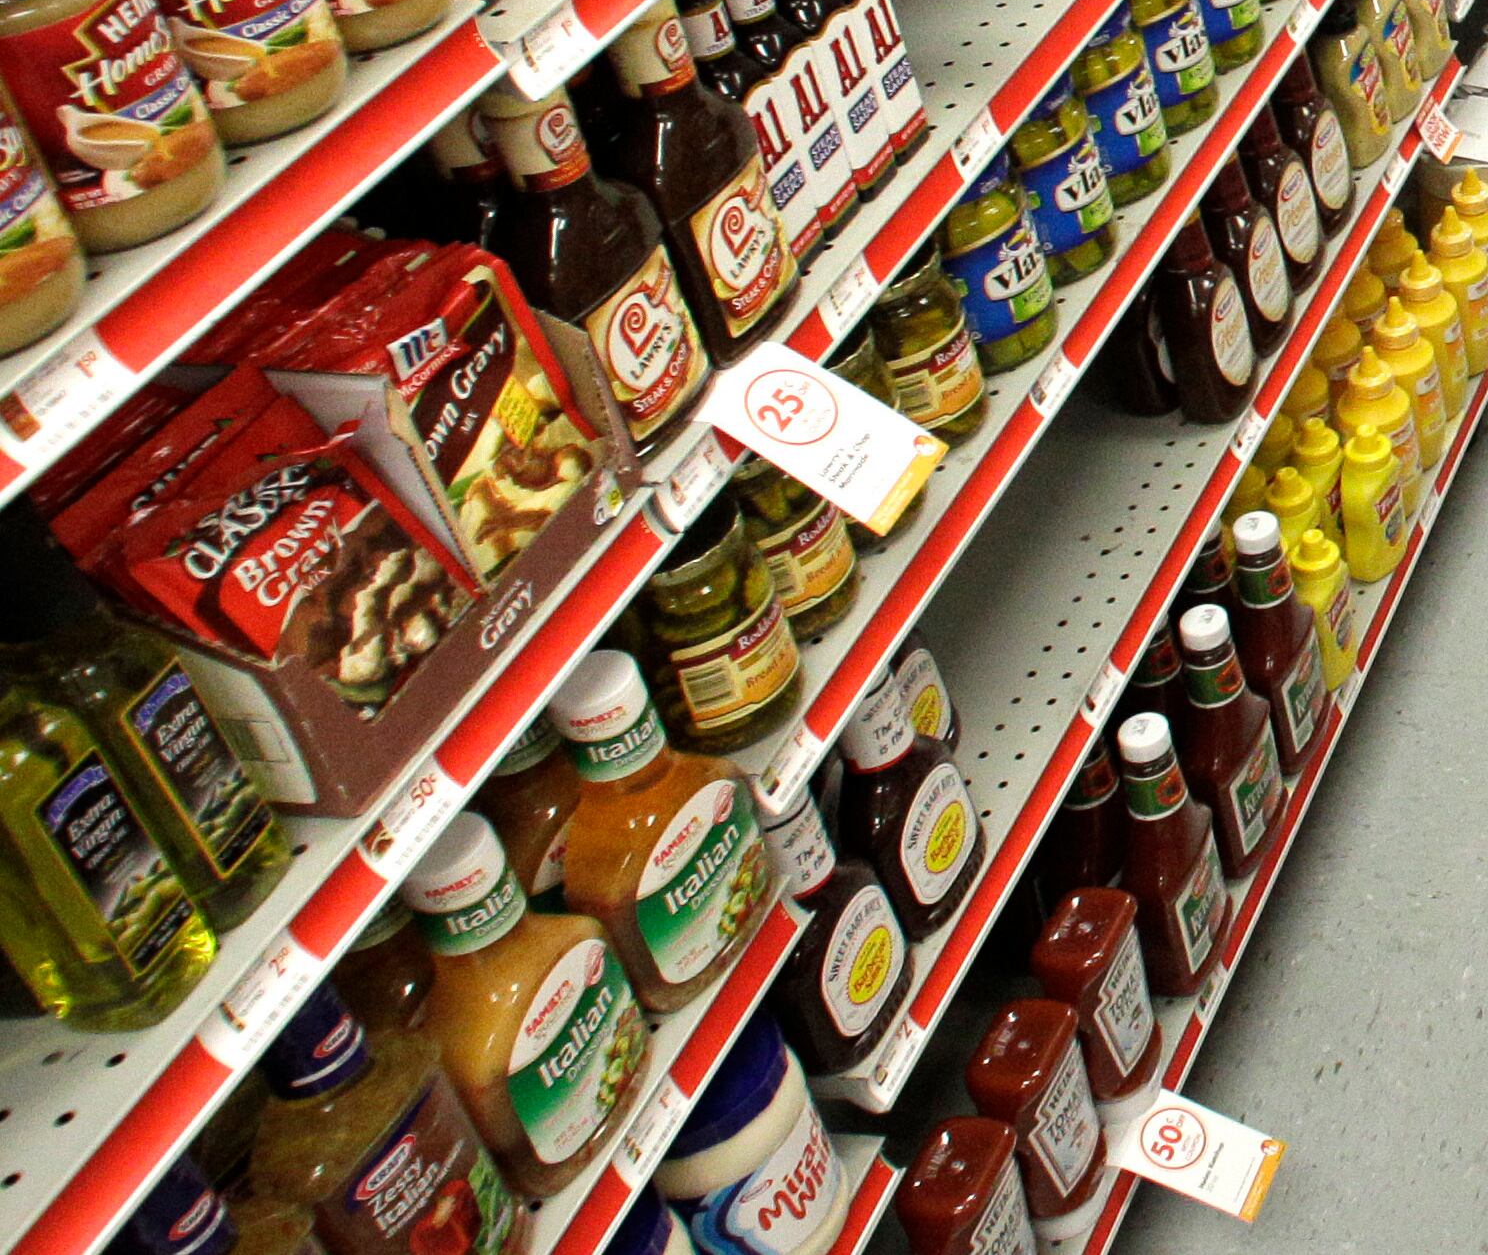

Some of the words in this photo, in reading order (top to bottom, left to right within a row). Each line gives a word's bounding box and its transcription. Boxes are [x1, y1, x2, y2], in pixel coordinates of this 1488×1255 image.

[241, 12, 288, 39] Classic
[883, 56, 911, 88] STEAK
[849, 89, 876, 121] STEAK
[811, 124, 839, 157] STEAK
[773, 161, 802, 196] STEAK
[732, 286, 756, 310] STEAK
[451, 324, 508, 399] Gravy
[633, 387, 659, 413] STEAK
[233, 499, 333, 592] Brown
[257, 517, 346, 607] Gravy
[482, 582, 533, 650] Gravy
[664, 825, 740, 915] Italian
[537, 988, 612, 1087] Italian
